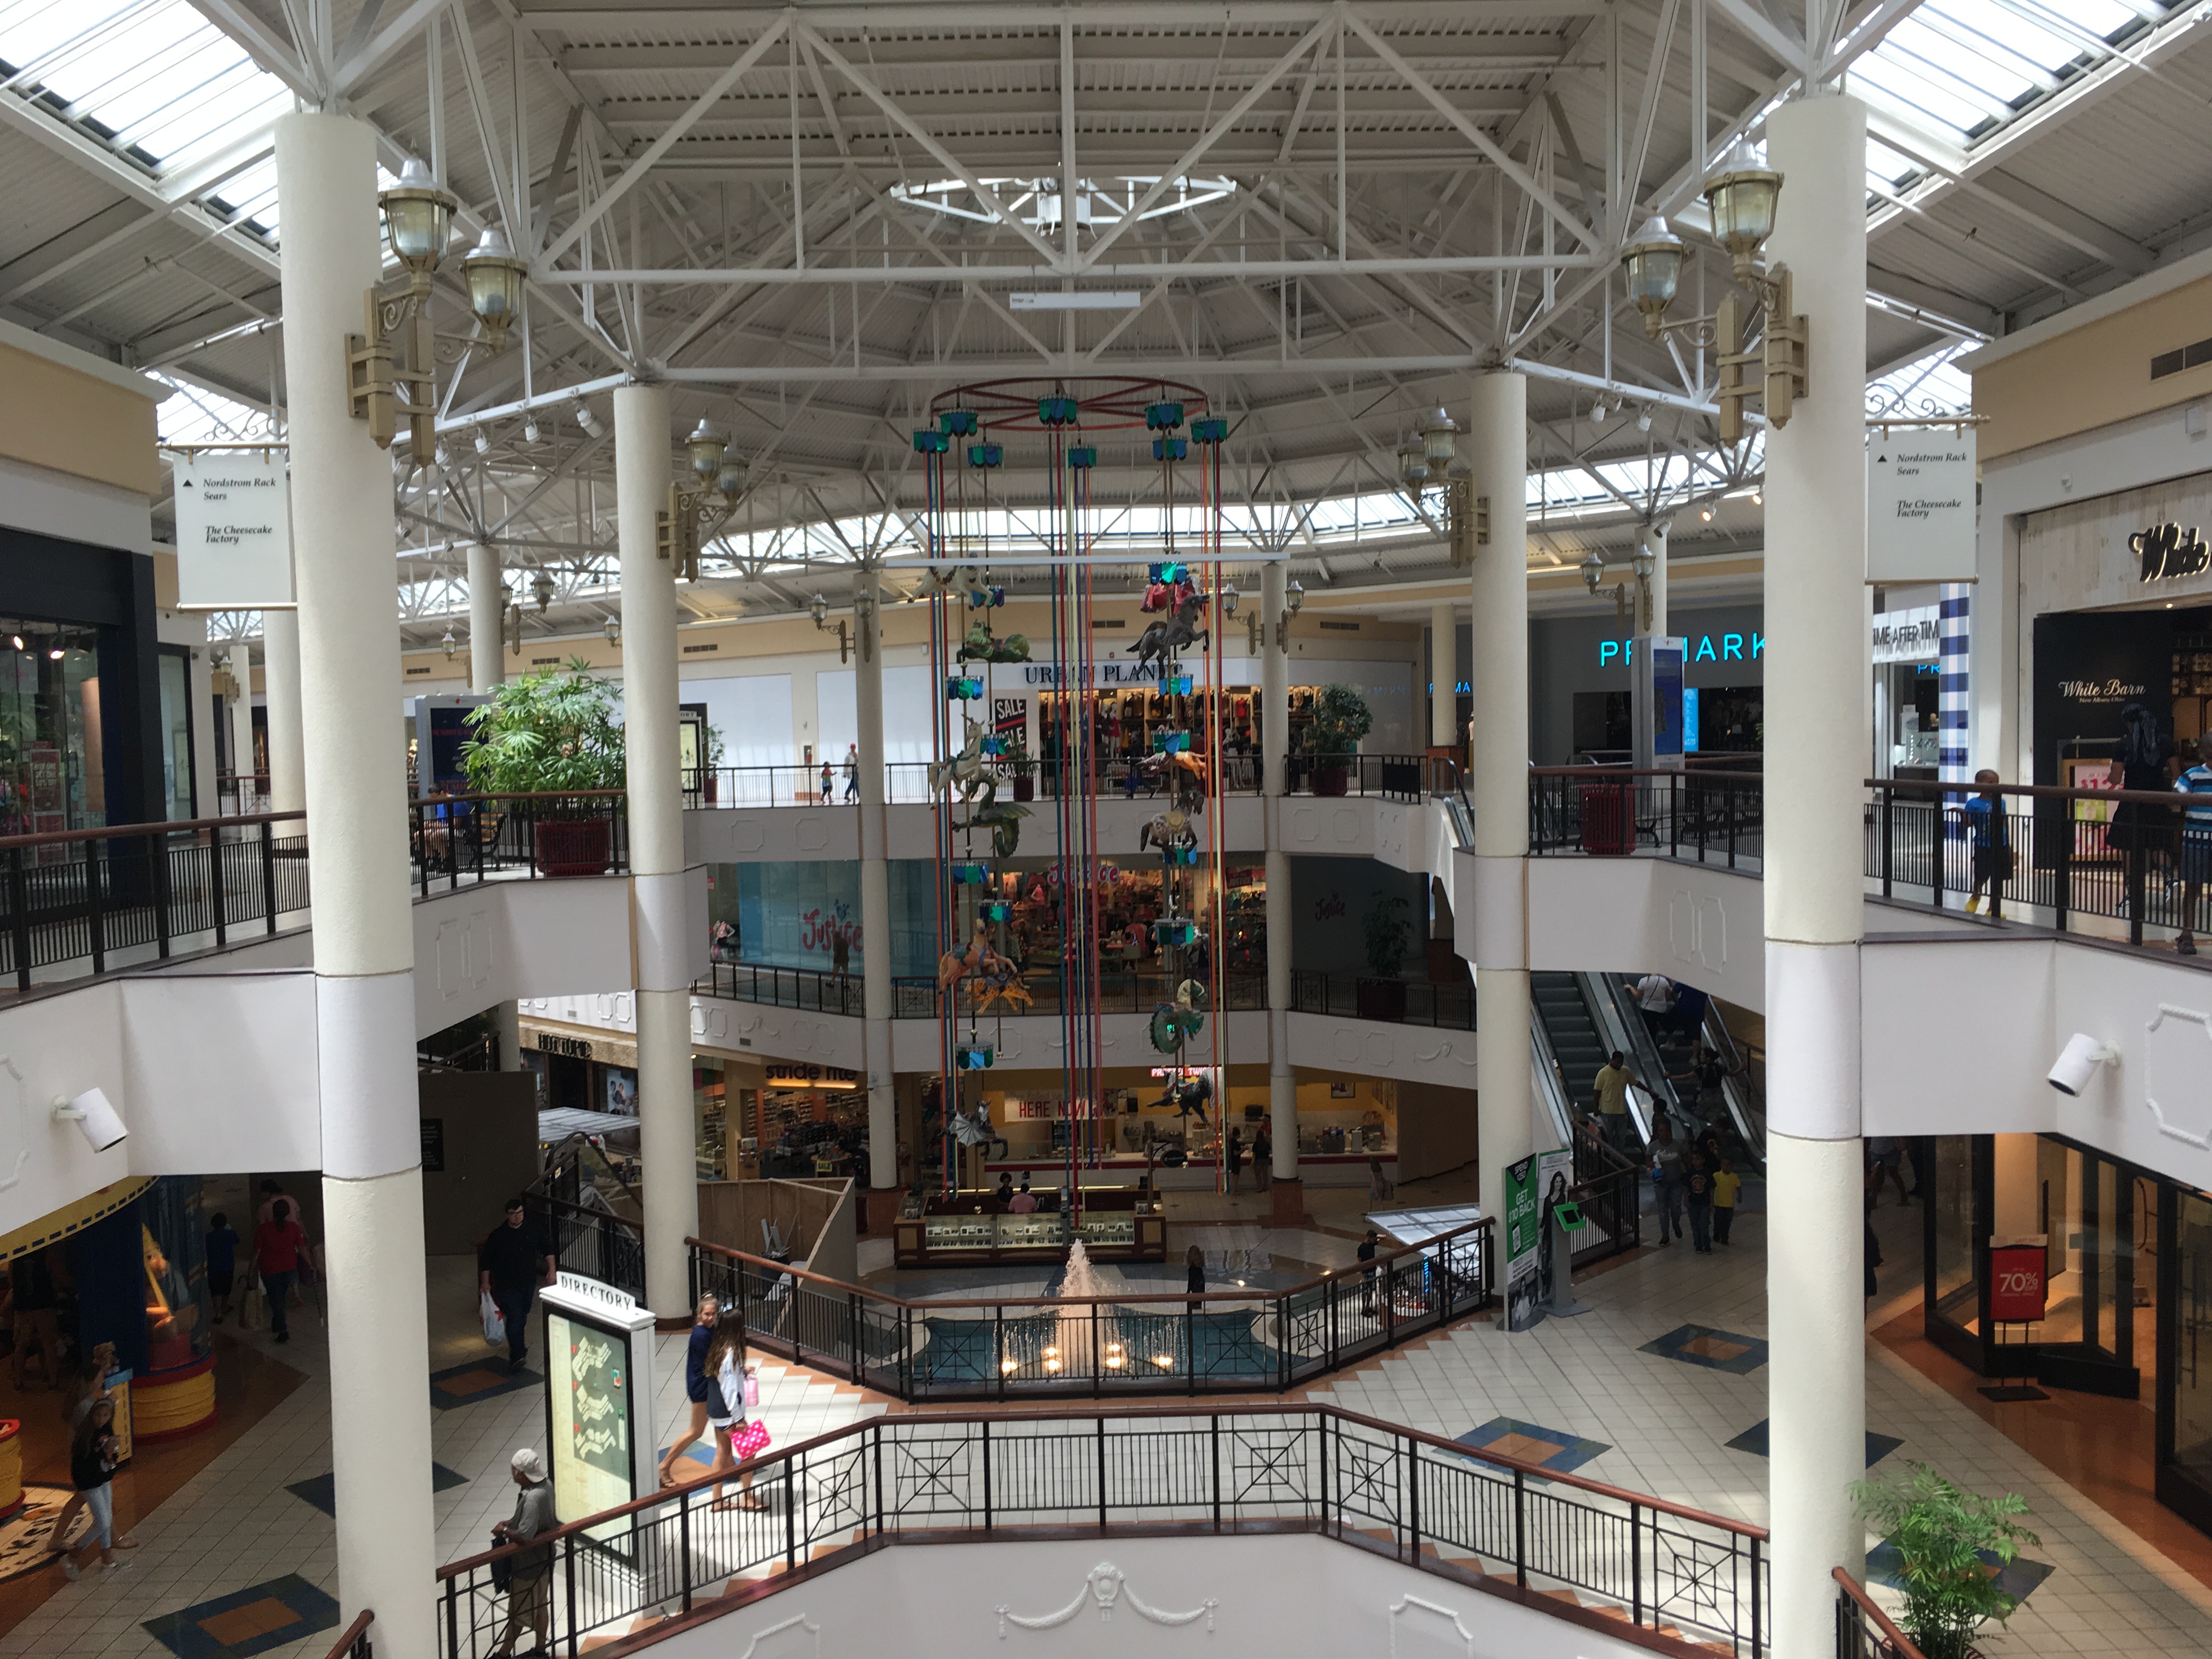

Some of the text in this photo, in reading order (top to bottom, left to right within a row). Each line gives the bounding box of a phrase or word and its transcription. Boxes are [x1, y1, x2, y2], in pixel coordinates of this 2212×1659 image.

[1897, 452, 1967, 462] Nordstrom Rack
[1897, 466, 1920, 475] Sears
[203, 478, 276, 487] Nordstrom Rack
[204, 491, 227, 500] Sears
[1897, 499, 1962, 510] The Cheesecake
[1897, 509, 1929, 520] Factory
[205, 525, 273, 535] The Cheesecake
[206, 534, 239, 545] Factory
[1873, 619, 1939, 646] IME AFTER TIM
[1600, 633, 1765, 667] PARK
[1103, 663, 1183, 682] PLANT
[2058, 679, 2146, 697] White Barn
[996, 698, 1025, 719] SALE
[538, 1034, 559, 1052] HOT
[766, 1063, 857, 1081] stride rite
[1019, 1101, 1051, 1118] HERE
[1516, 1188, 1528, 1205] GET
[1509, 1197, 1536, 1224] $10 BACK
[2000, 1272, 2038, 1292] 70%
[561, 1276, 631, 1310] DIRECTORY
